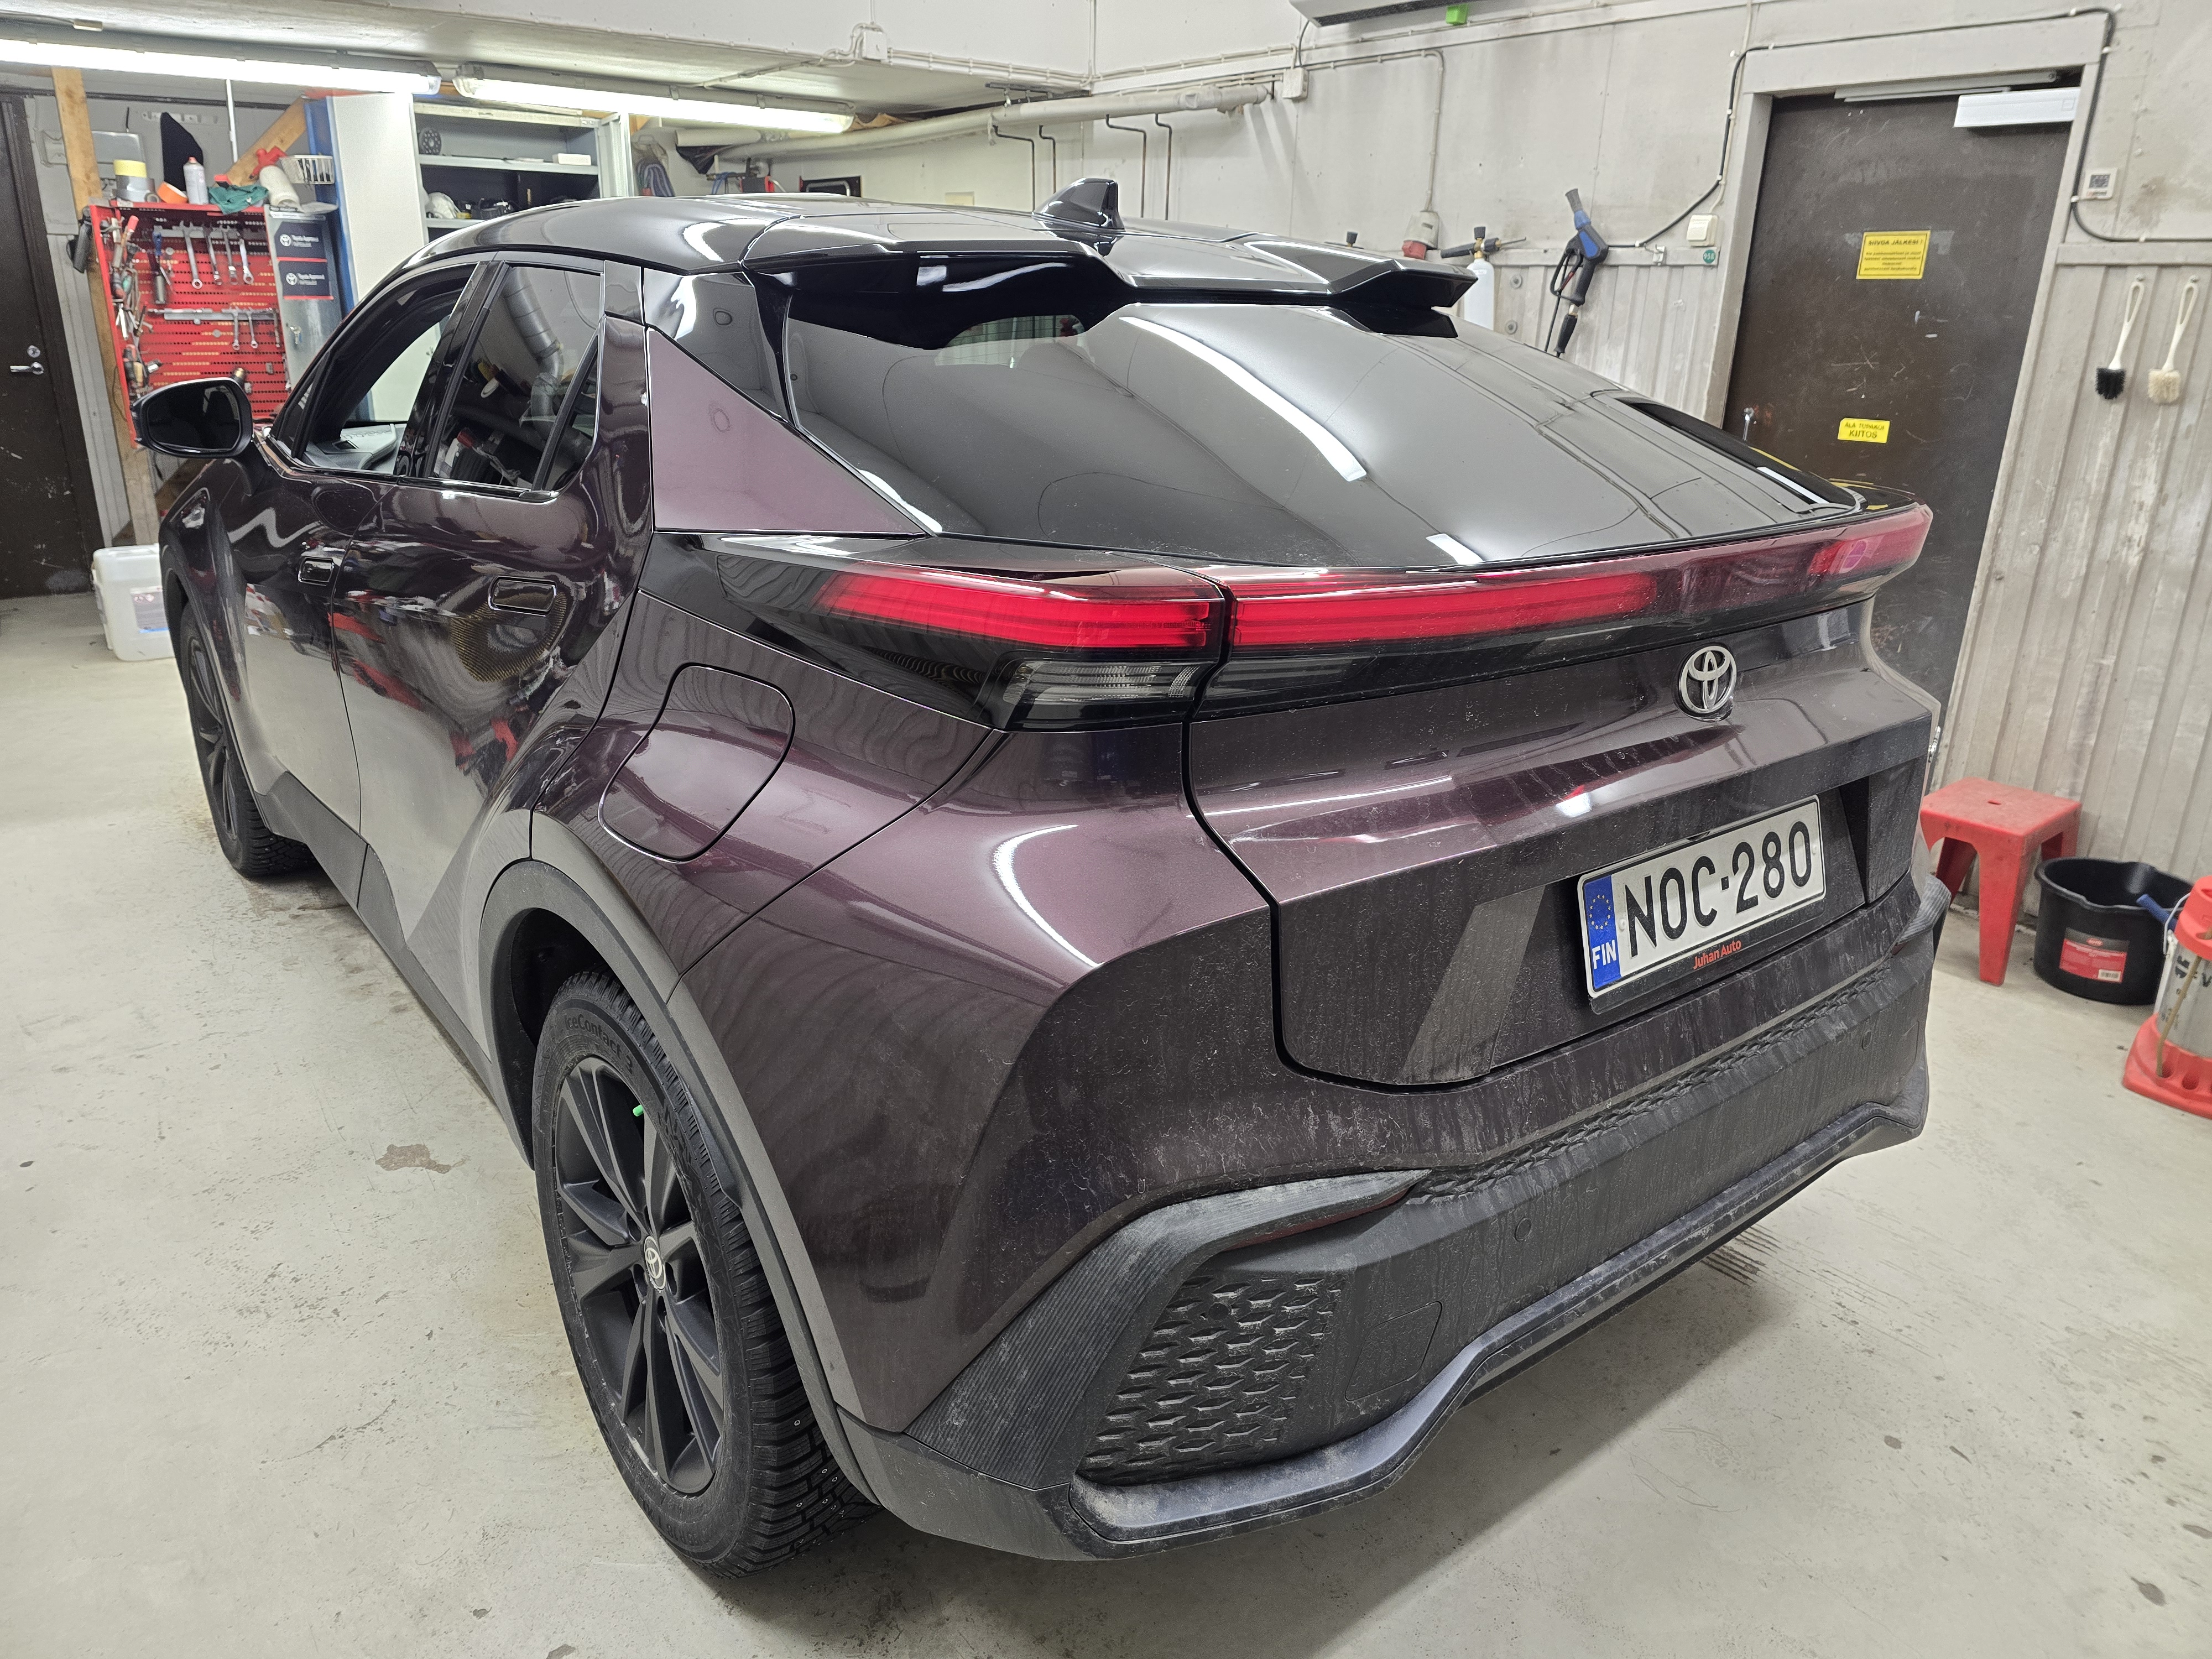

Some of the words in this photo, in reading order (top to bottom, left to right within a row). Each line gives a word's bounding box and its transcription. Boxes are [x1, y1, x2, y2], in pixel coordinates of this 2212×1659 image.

[1849, 430, 1877, 439] KIITOS
[1625, 821, 1812, 958] NOC-280
[1591, 940, 1617, 969] FIN
[1693, 950, 1720, 970] Juhan
[1720, 940, 1741, 958] Auto
[564, 1014, 622, 1061] IceContact
[625, 1055, 633, 1075] 3
